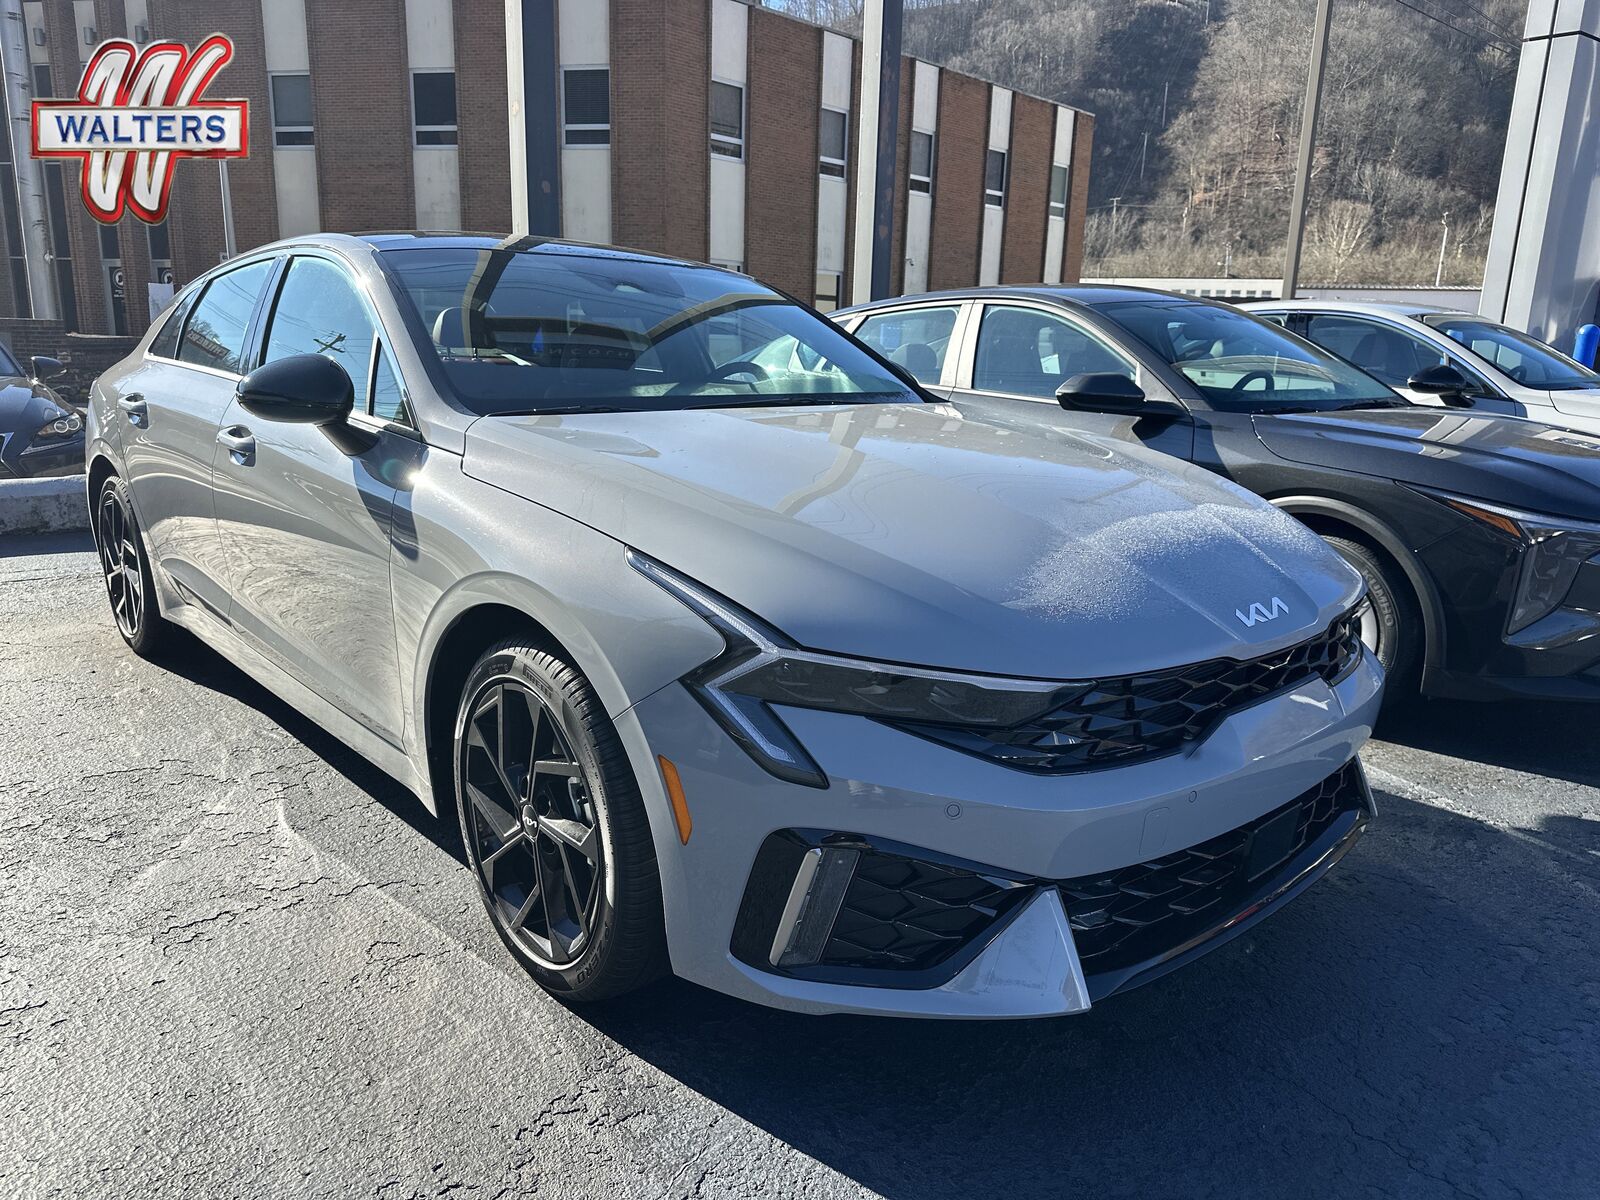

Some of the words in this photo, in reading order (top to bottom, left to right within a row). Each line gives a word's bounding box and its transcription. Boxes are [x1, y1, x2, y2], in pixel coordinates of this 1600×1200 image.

[1235, 596, 1289, 627] KIA
[1362, 569, 1394, 627] KUMHO
[523, 663, 553, 699] PIRELLI
